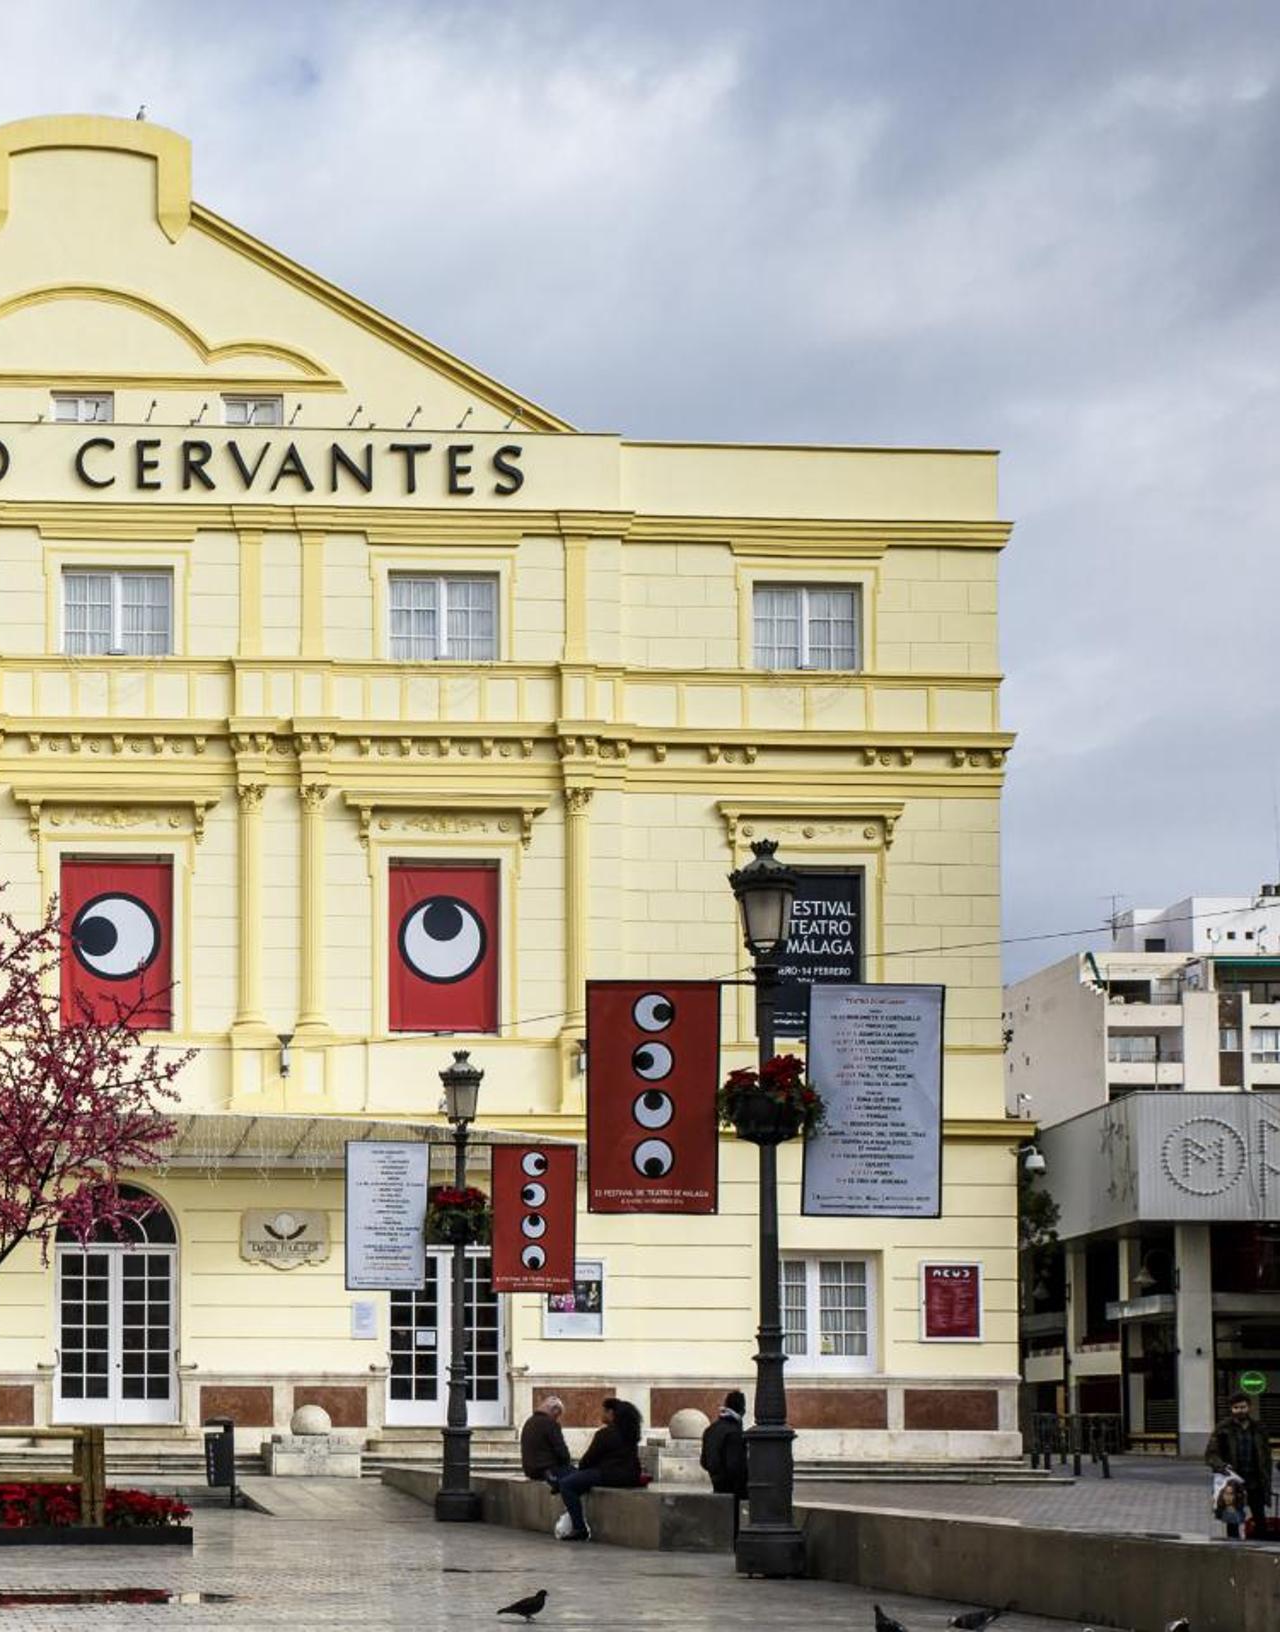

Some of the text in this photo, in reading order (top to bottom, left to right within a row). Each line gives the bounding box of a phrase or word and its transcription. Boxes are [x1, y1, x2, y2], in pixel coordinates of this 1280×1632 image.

[74, 437, 526, 496] CERVANTES
[792, 900, 857, 916] ESTIVAL
[788, 919, 852, 936] TEATRO
[785, 934, 855, 955] MÁLAGA
